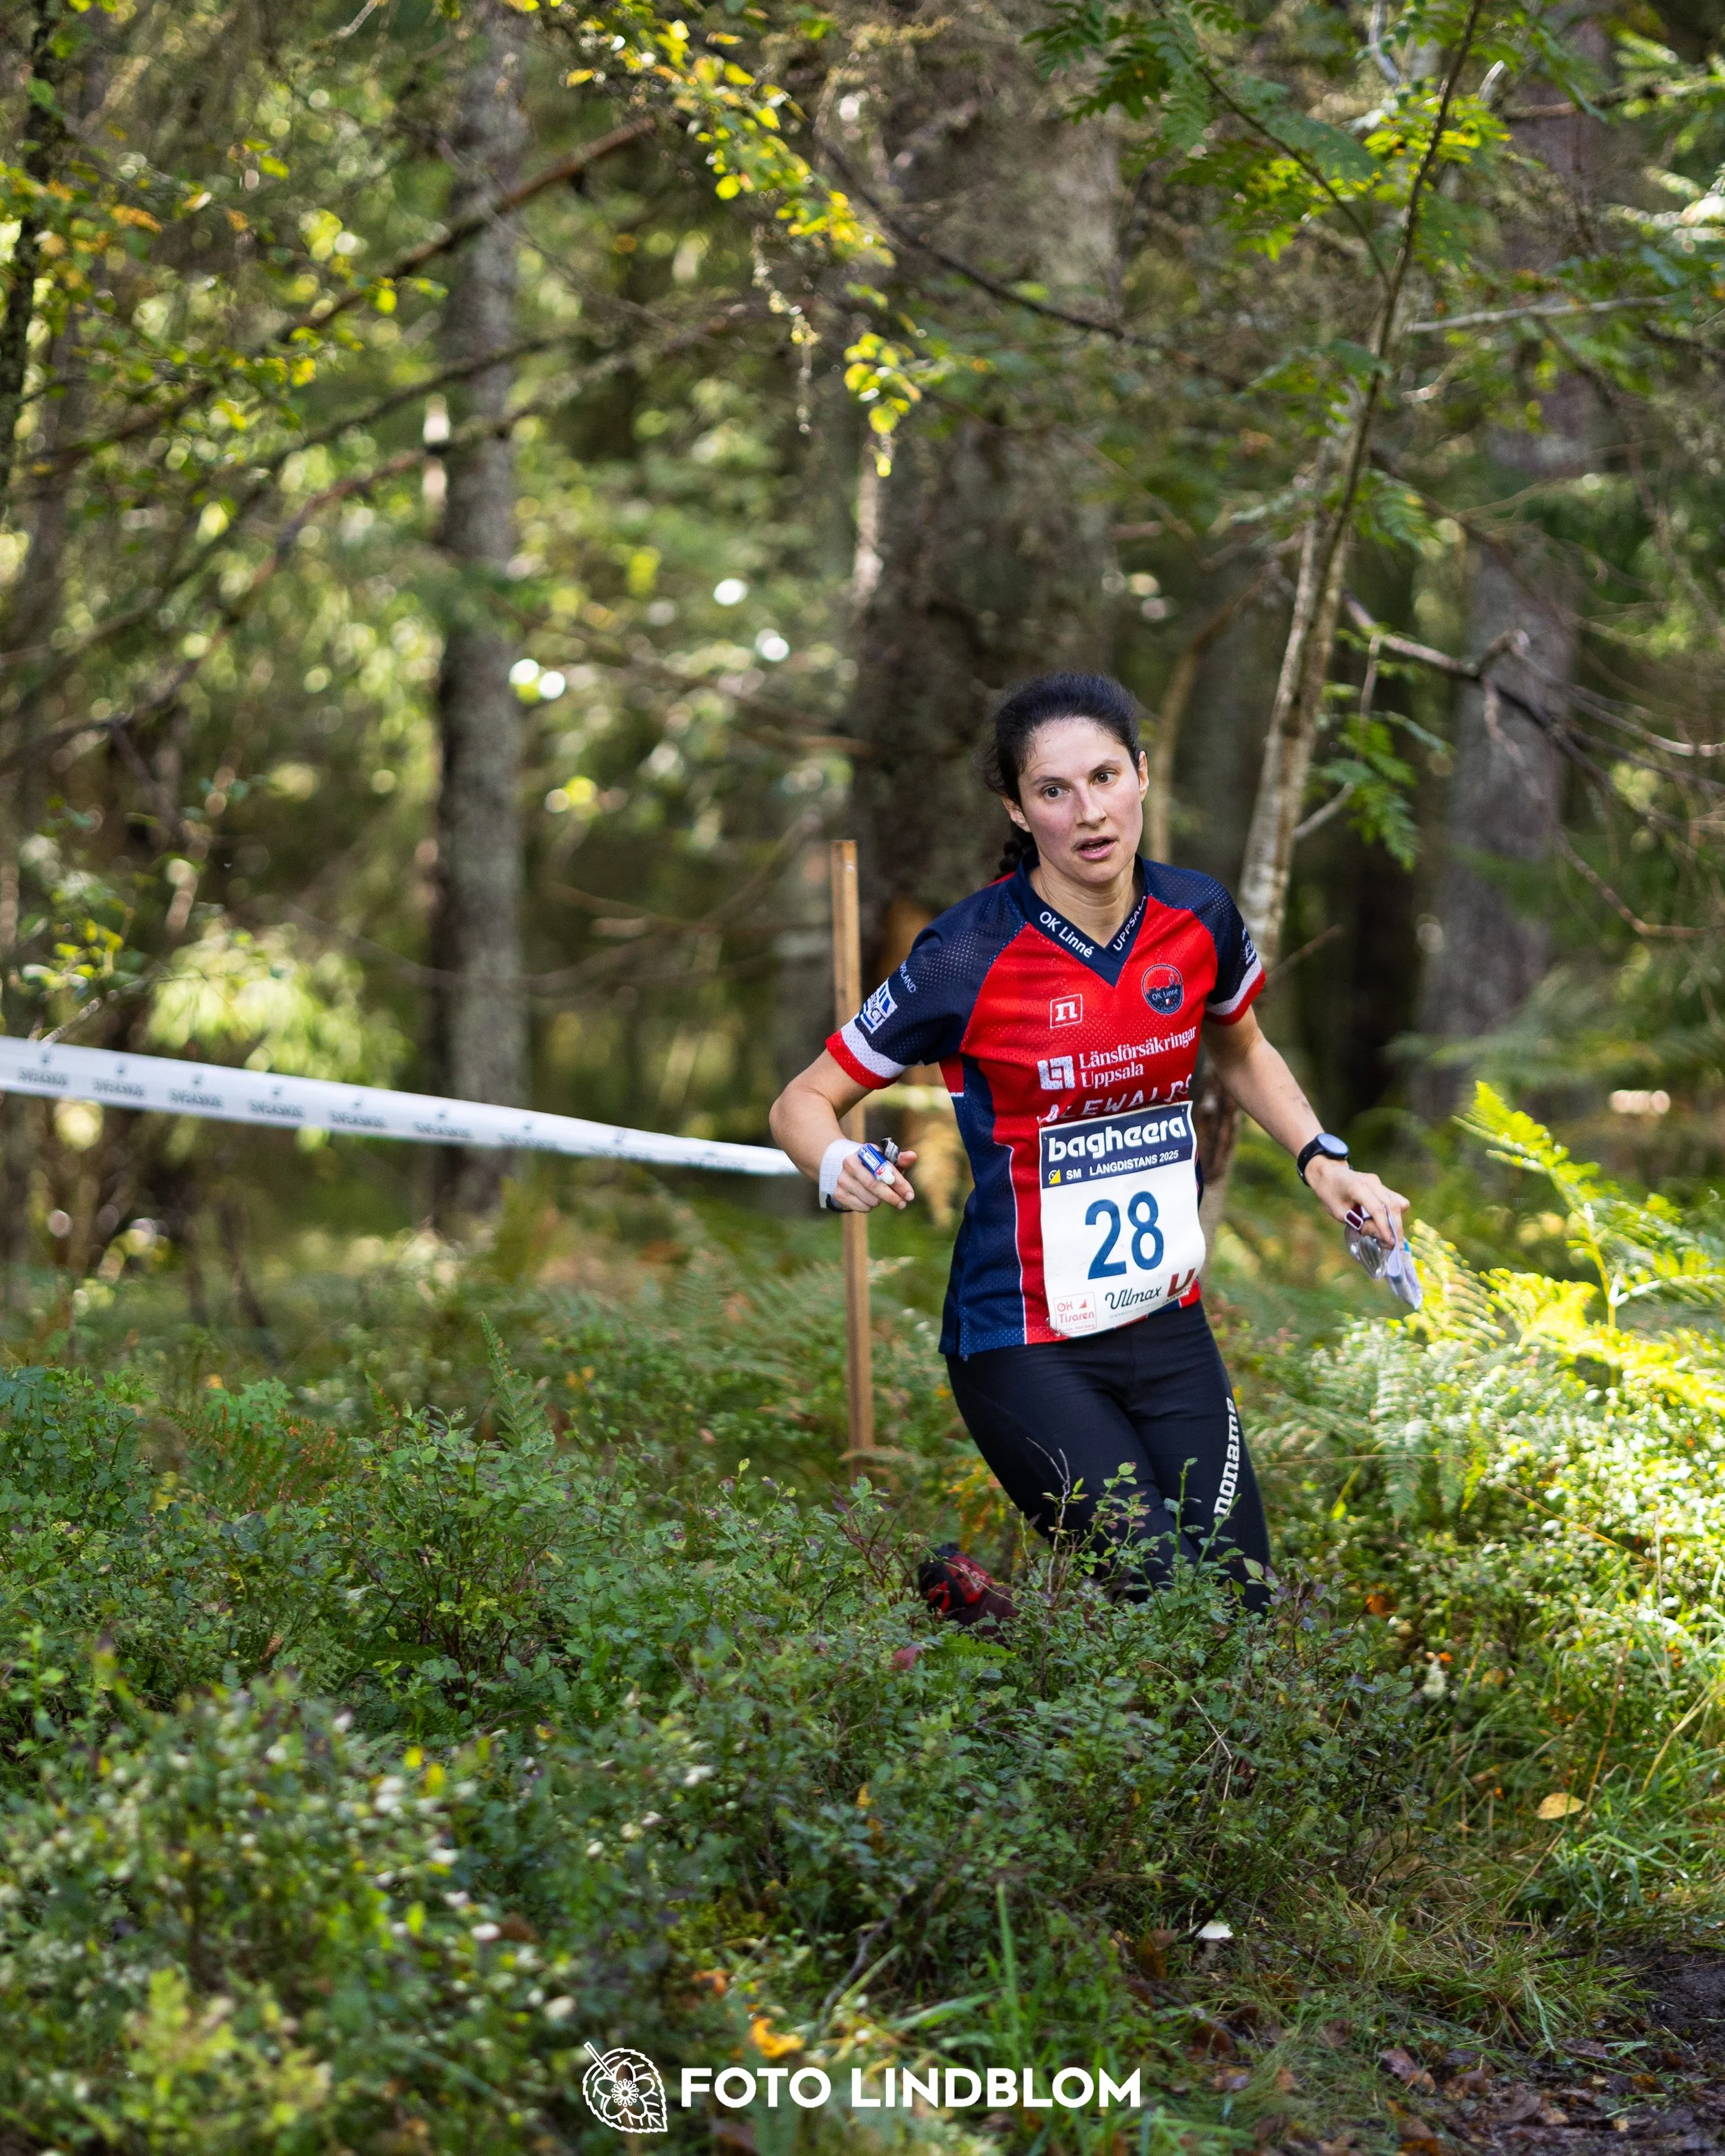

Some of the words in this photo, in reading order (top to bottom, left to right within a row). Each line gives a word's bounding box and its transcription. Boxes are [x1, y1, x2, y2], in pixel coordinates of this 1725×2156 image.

[1039, 911, 1058, 933] OK
[1058, 925, 1095, 958] Linné
[1152, 991, 1163, 1000] OK
[1078, 1026, 1196, 1069] Länsförsäkringar
[1081, 1061, 1144, 1088] Uppsala
[1048, 1116, 1187, 1162] bagheera
[1066, 1168, 1082, 1180] SM
[1090, 1155, 1158, 1176] LÅNGDISTANS
[1159, 1149, 1179, 1163] 2025
[1085, 1191, 1164, 1280] 28
[1105, 1286, 1163, 1309] Ullmax
[1059, 1311, 1094, 1323] Tisaren
[1213, 1396, 1240, 1516] noname
